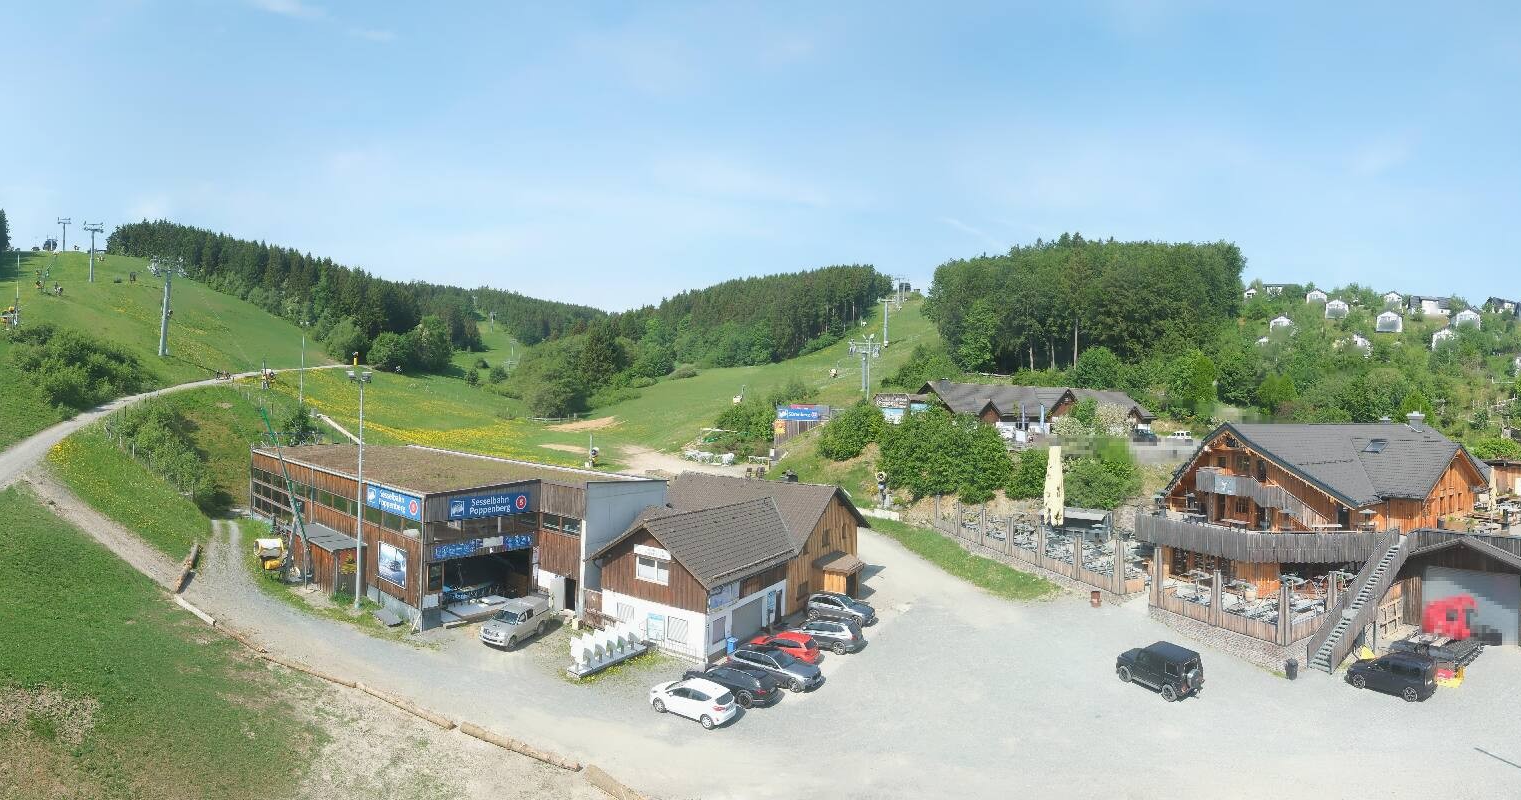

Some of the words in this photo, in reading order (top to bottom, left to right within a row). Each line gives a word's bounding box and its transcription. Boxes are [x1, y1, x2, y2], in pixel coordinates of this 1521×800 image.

[379, 489, 405, 503] Sesselbahn
[471, 495, 510, 507] Sesselbahn
[469, 504, 511, 516] Poppenberg
